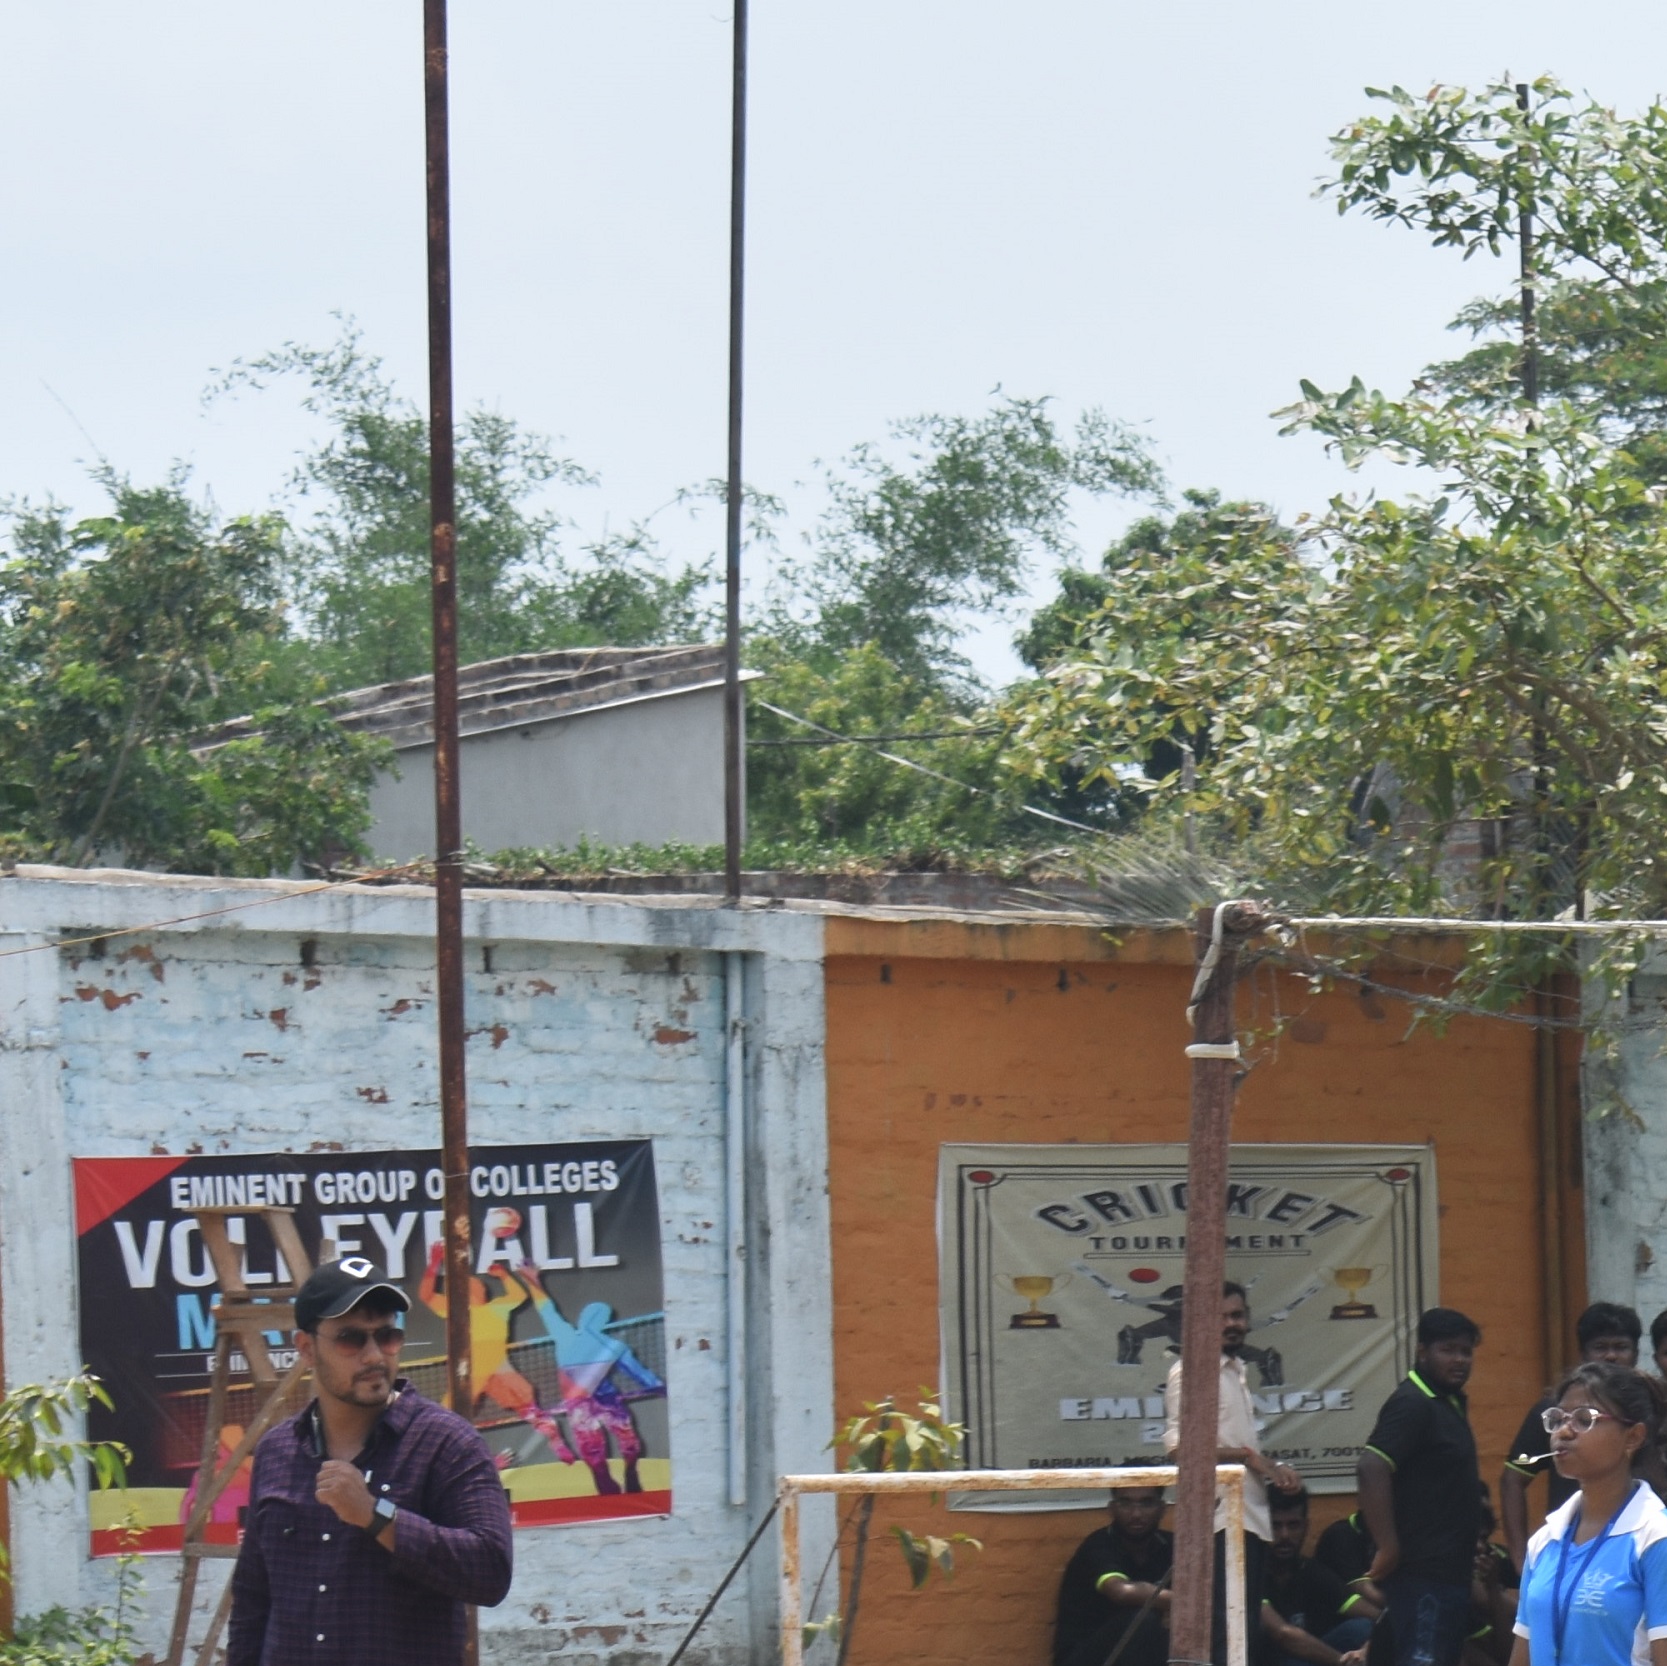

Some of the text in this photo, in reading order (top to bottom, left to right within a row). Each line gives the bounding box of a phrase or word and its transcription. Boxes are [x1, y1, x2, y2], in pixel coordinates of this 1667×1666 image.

[170, 1173, 307, 1209] EMINENT
[314, 1169, 417, 1205] GROUP
[470, 1160, 620, 1198] COLLEGES
[114, 1203, 619, 1289] VOLEYALL
[1089, 1234, 1306, 1250] TOURMENT
[1060, 1389, 1354, 1420] EMINCE
